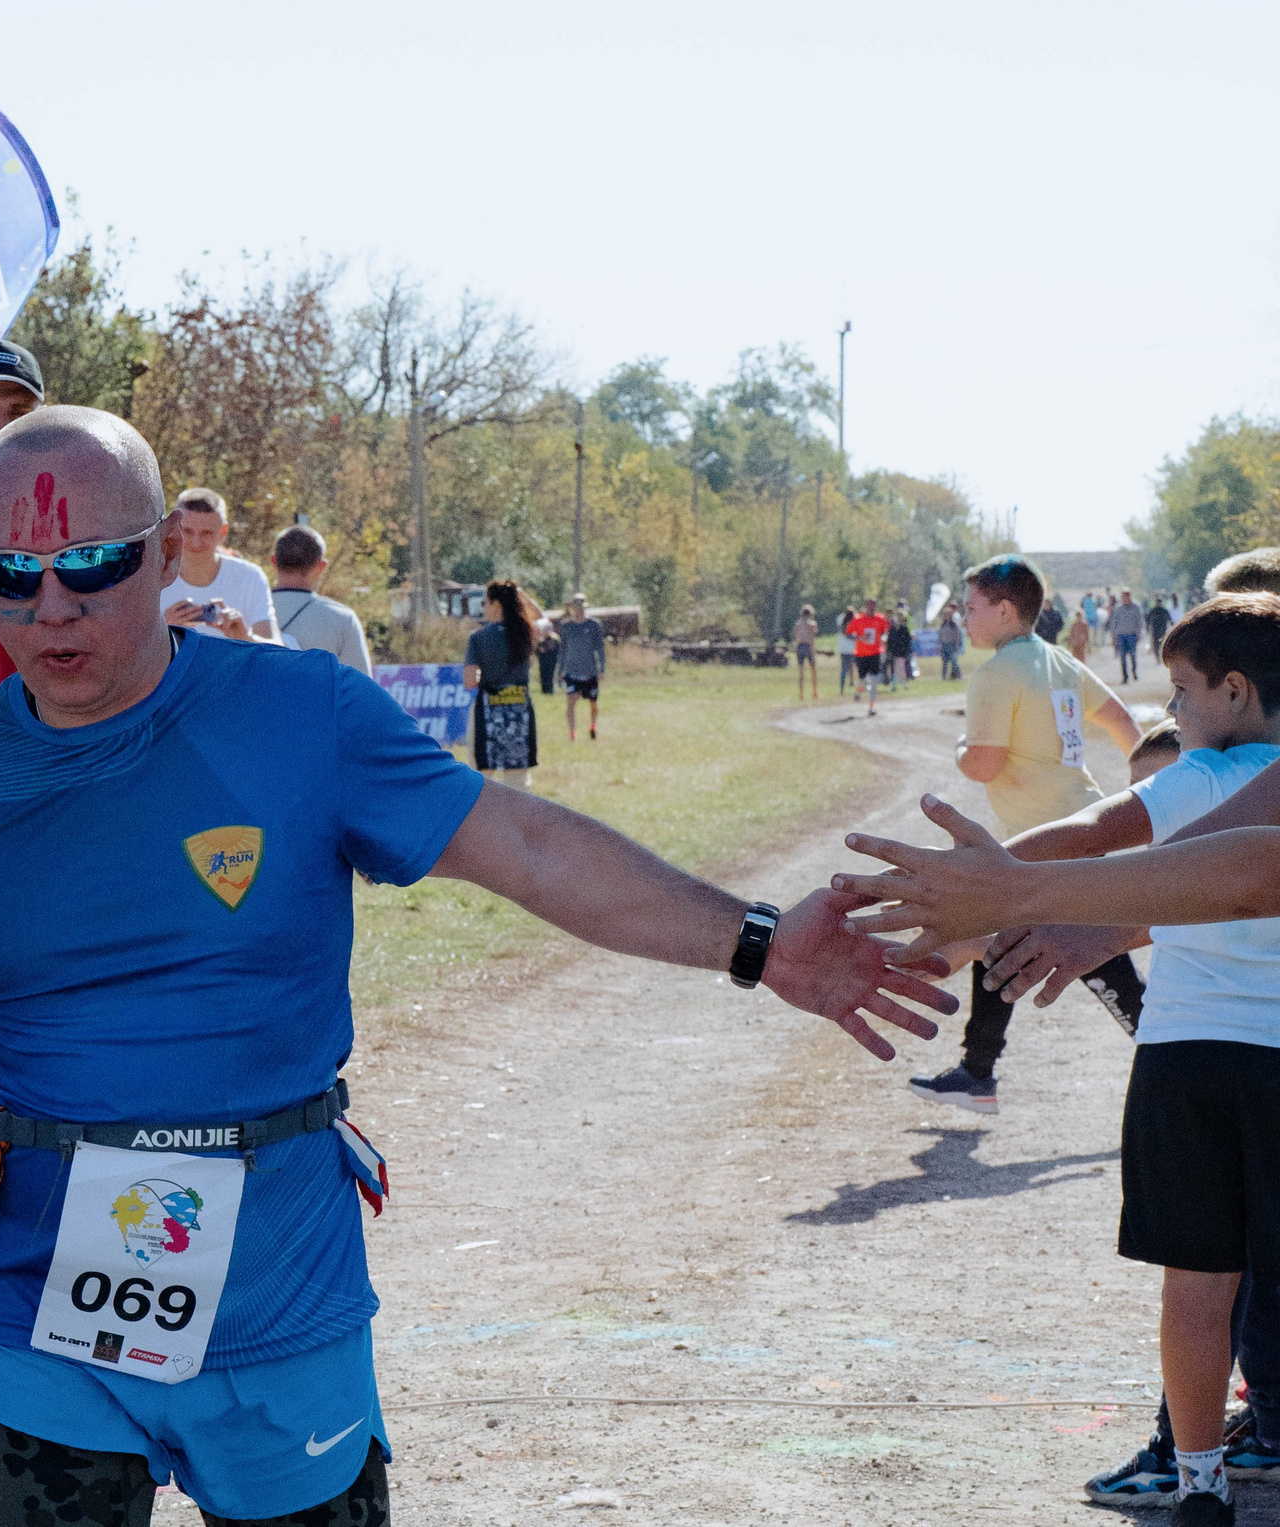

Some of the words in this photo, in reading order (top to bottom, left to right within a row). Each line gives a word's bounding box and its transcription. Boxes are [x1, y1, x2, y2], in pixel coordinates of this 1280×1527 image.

[229, 853, 254, 863] RUN
[131, 1127, 240, 1148] AONIJIE
[71, 1271, 196, 1331] 069
